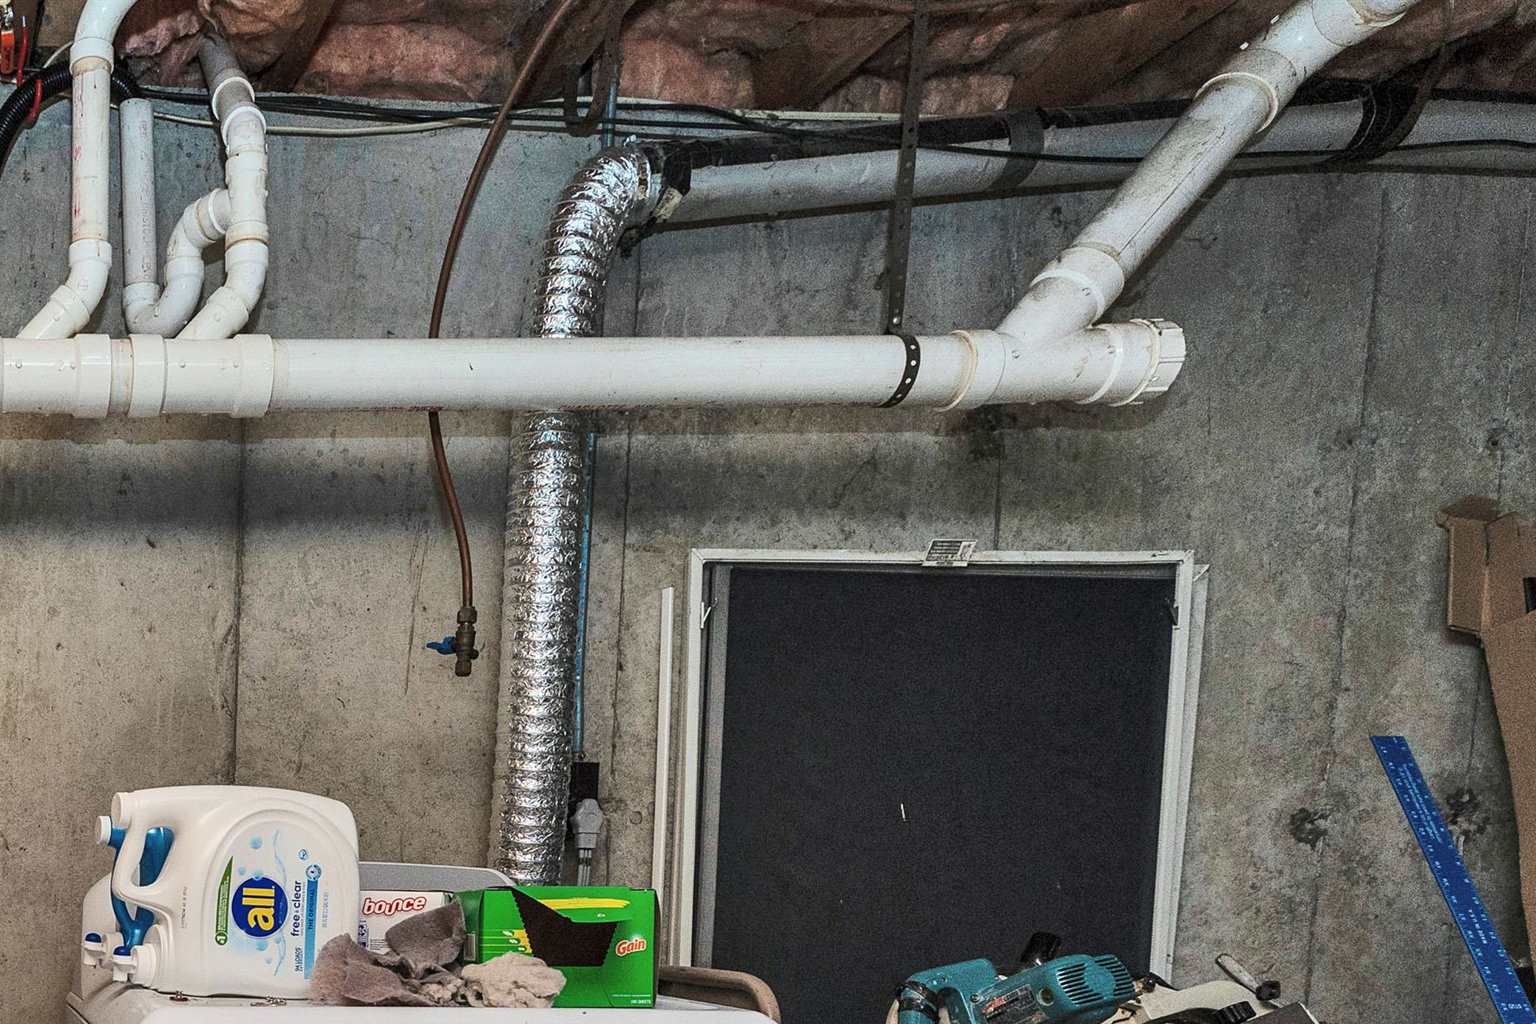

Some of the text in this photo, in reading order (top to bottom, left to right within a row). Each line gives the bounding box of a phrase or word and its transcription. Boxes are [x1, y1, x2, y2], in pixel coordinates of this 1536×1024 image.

[293, 880, 302, 909] clear
[362, 896, 427, 916] bounce
[242, 886, 275, 931] all
[290, 914, 301, 937] free
[616, 938, 646, 956] Gain
